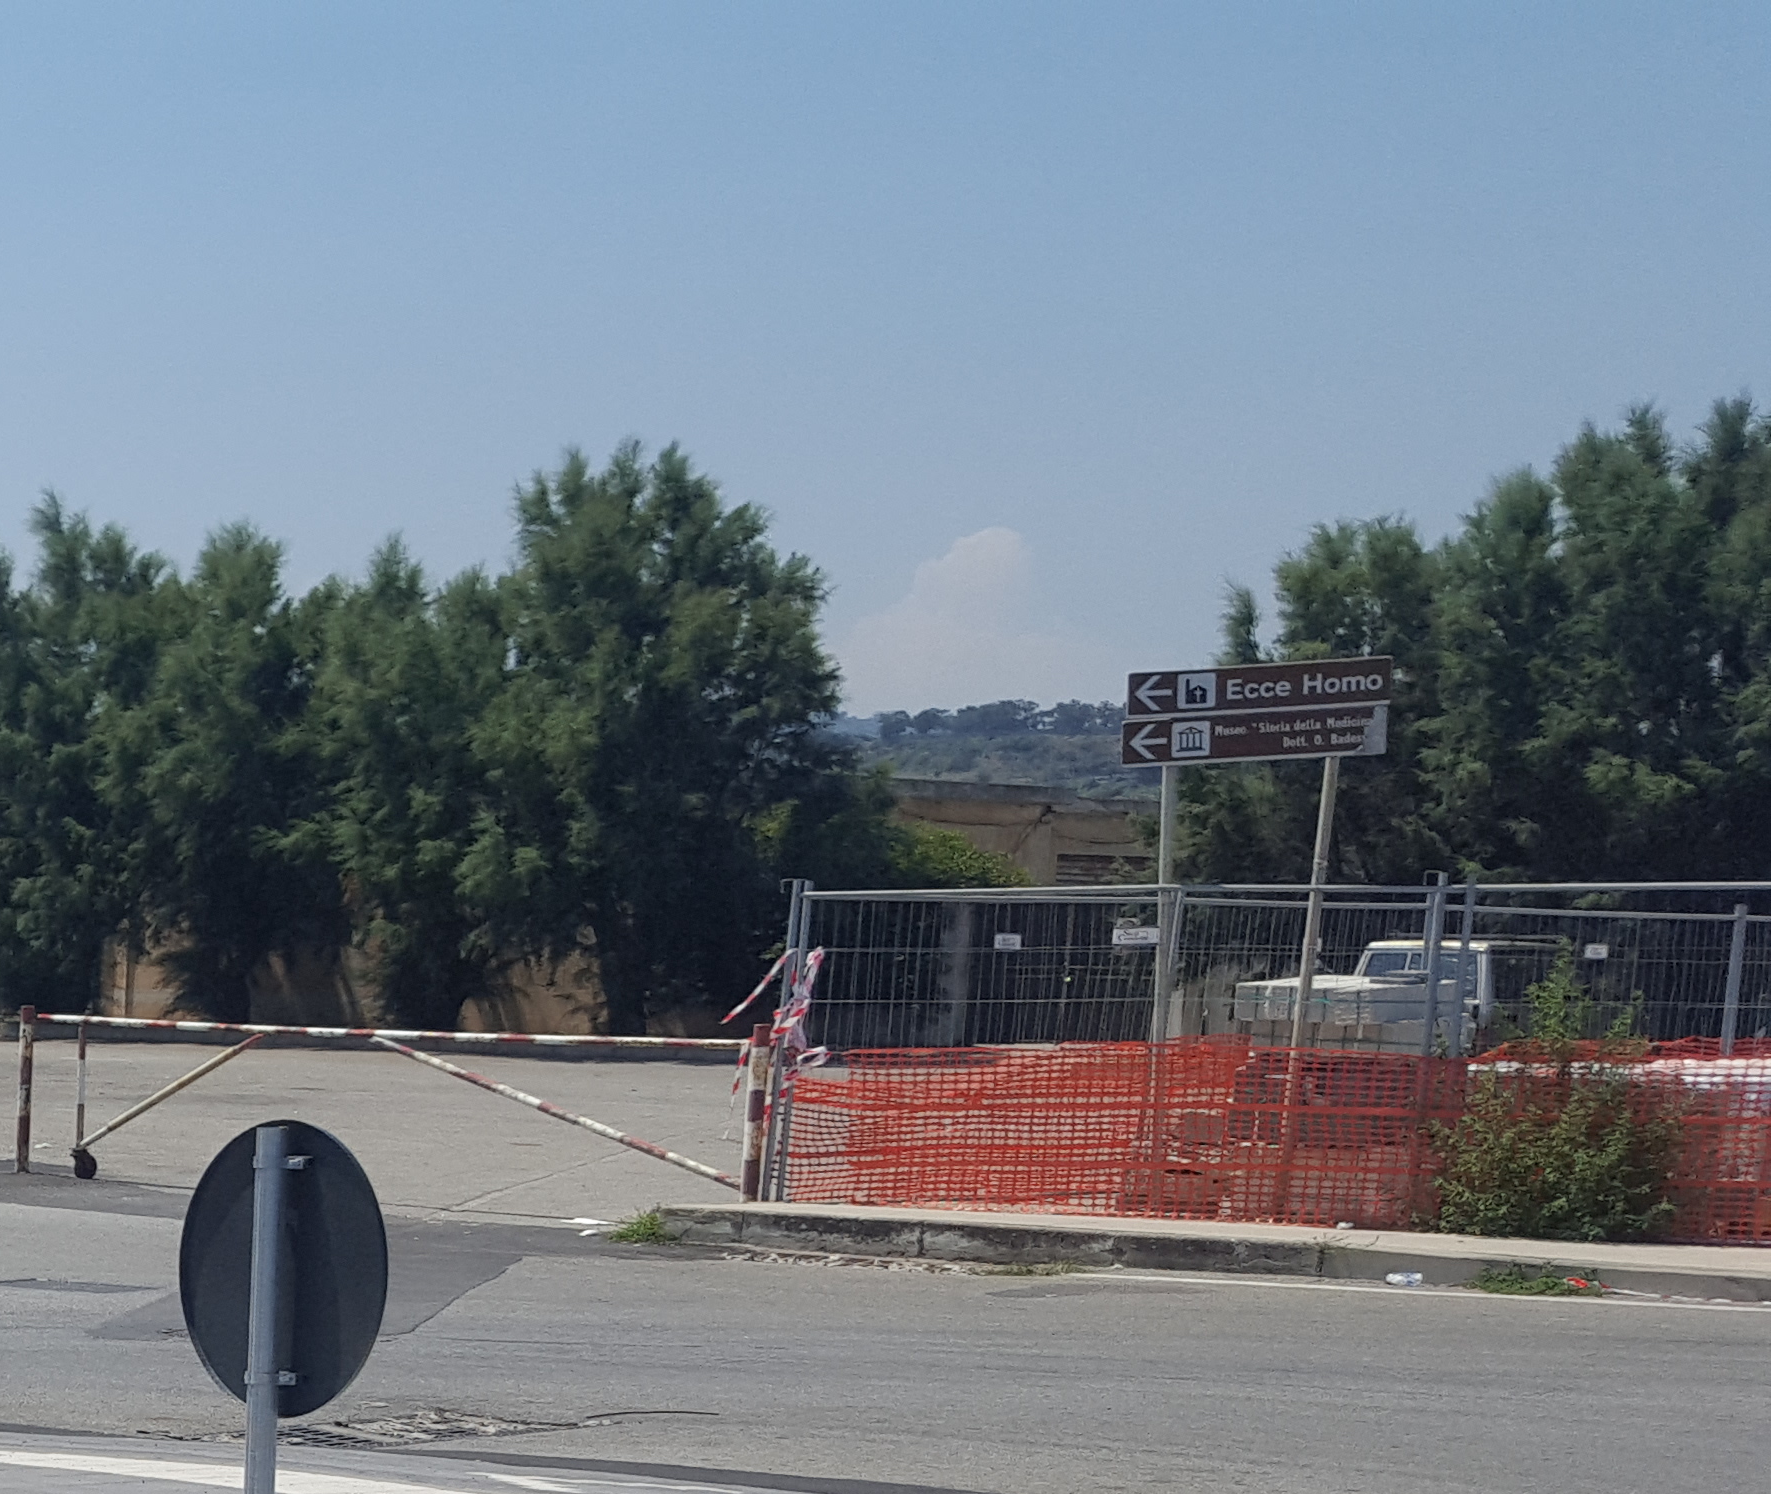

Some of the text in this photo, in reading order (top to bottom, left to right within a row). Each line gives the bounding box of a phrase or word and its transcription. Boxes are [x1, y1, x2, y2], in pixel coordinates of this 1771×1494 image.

[1226, 673, 1384, 701] Ecce Homo
[1294, 718, 1321, 731] della
